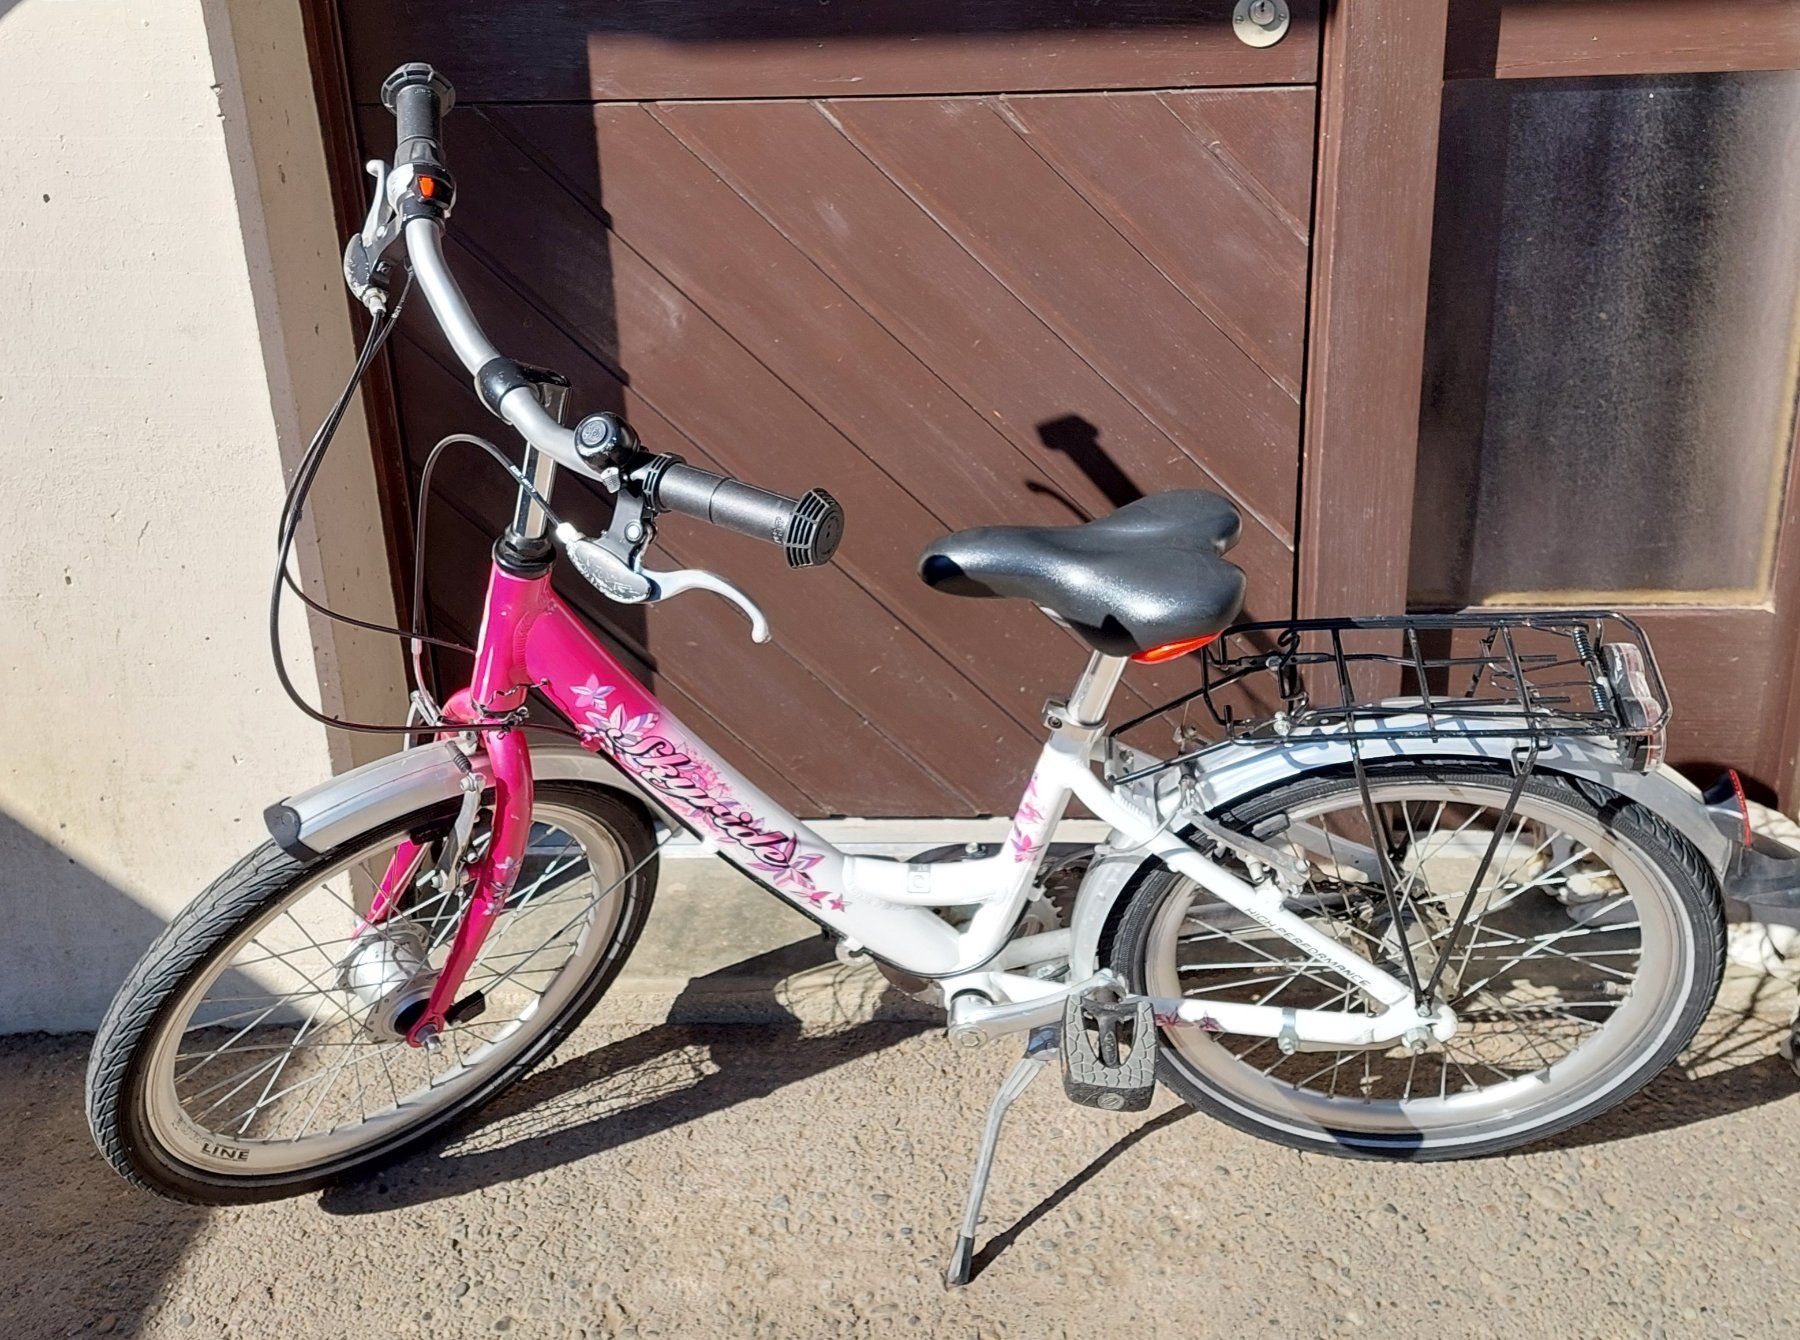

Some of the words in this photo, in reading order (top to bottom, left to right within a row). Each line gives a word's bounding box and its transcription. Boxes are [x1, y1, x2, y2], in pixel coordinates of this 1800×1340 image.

[605, 727, 790, 868] Skyride
[1244, 907, 1276, 928] HIGH
[1276, 927, 1371, 986] PERFORMANCE
[202, 1142, 250, 1160] LINE
